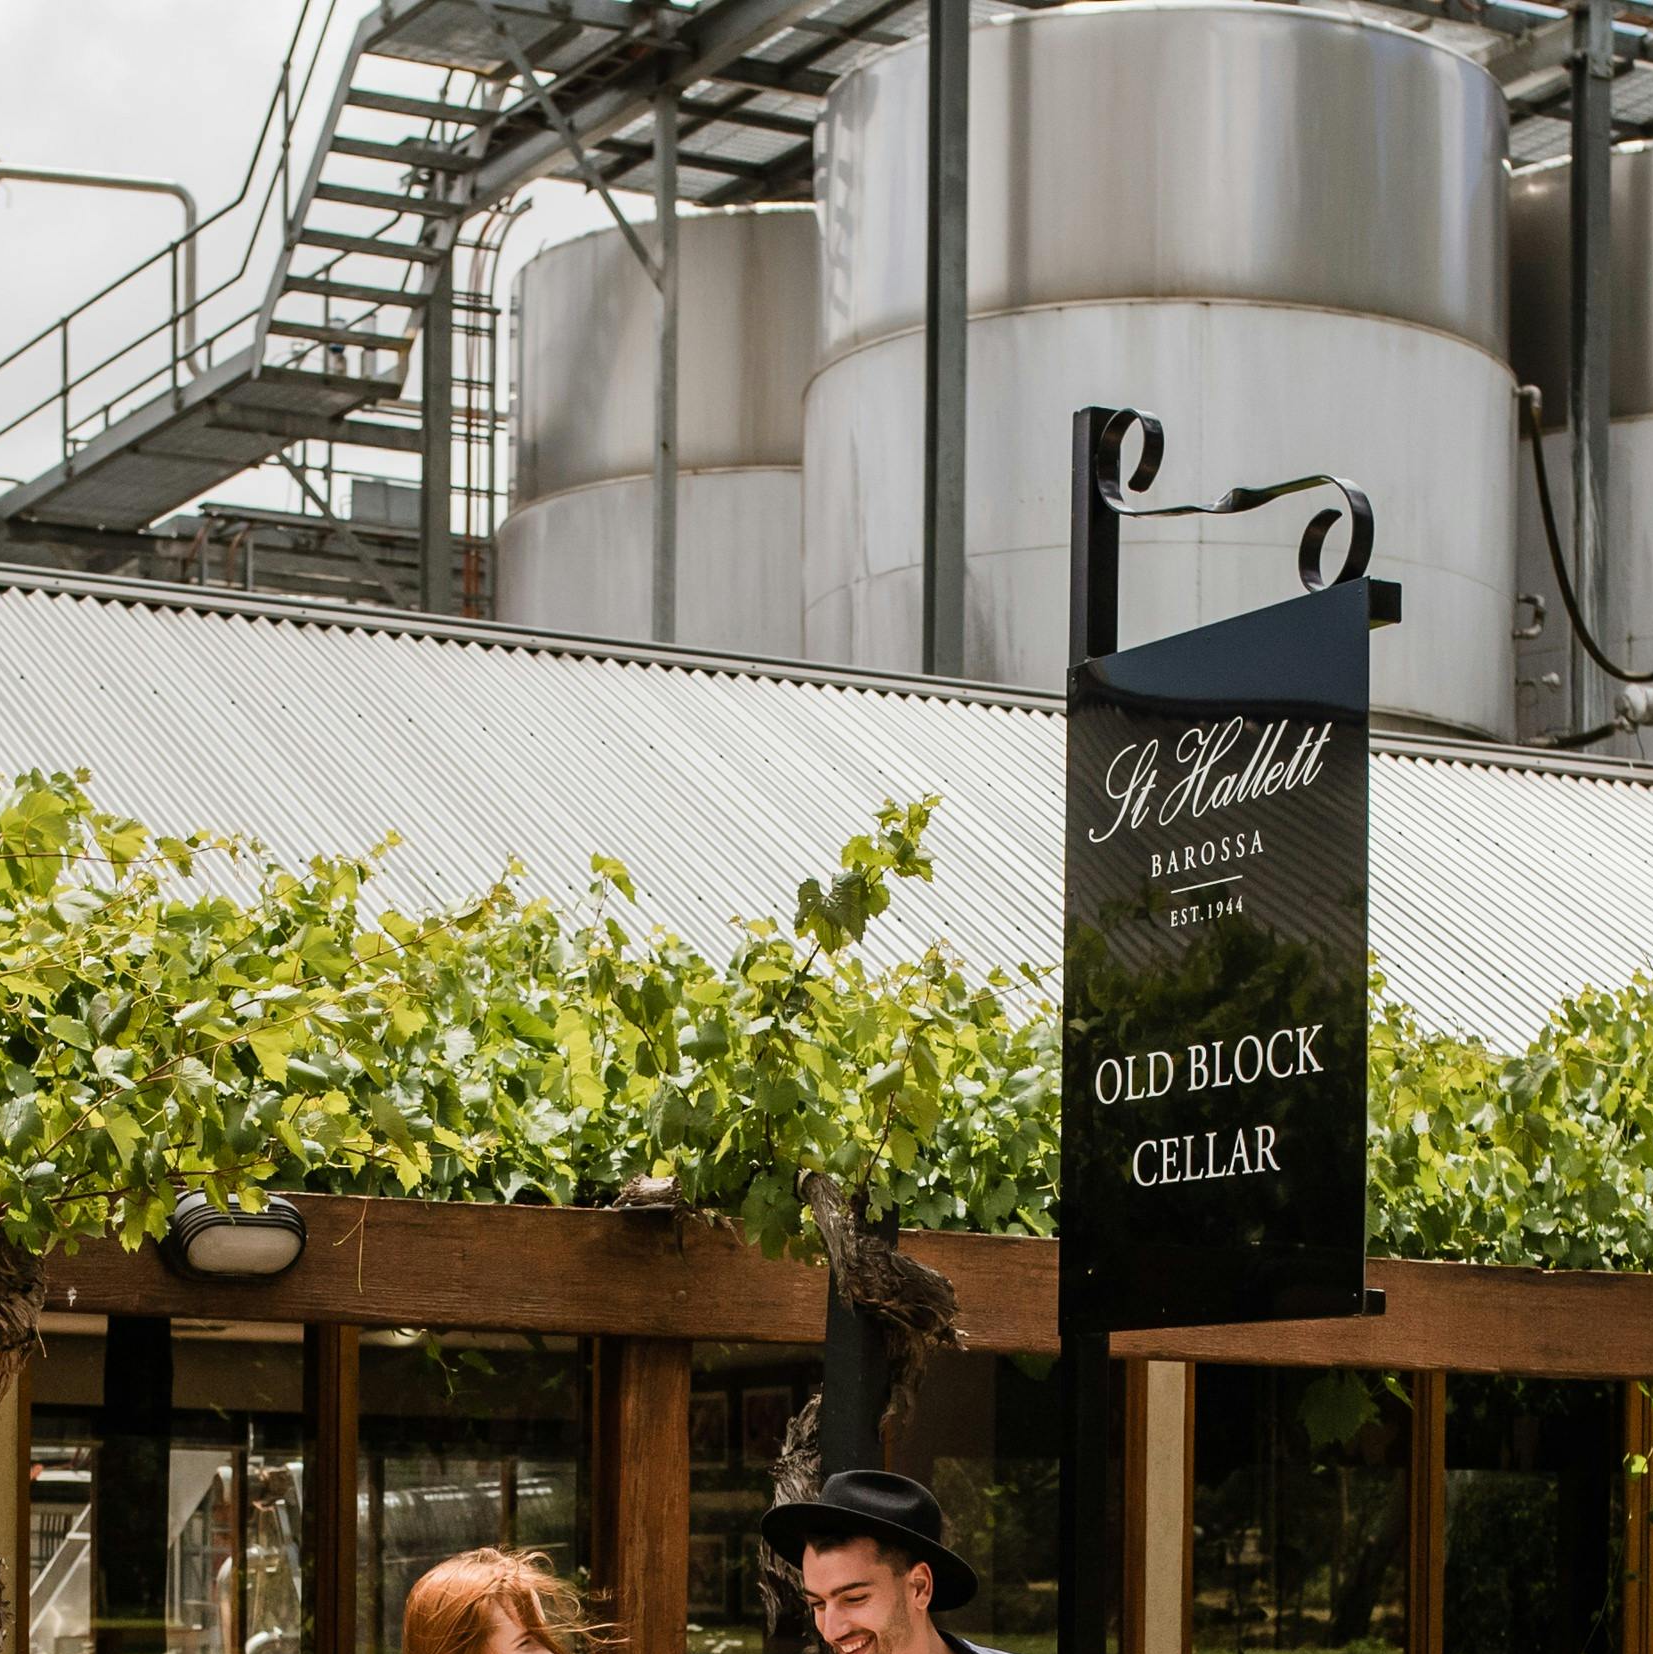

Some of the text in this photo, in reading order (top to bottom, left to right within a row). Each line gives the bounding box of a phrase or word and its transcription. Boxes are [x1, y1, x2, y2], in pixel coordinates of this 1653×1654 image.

[1088, 715, 1333, 843] St Hallett
[1150, 829, 1265, 878] BAROSSA
[1169, 894, 1245, 929] EST.1944
[1095, 1024, 1324, 1105] OLD BLOCK
[1132, 1125, 1281, 1187] CELLAR
